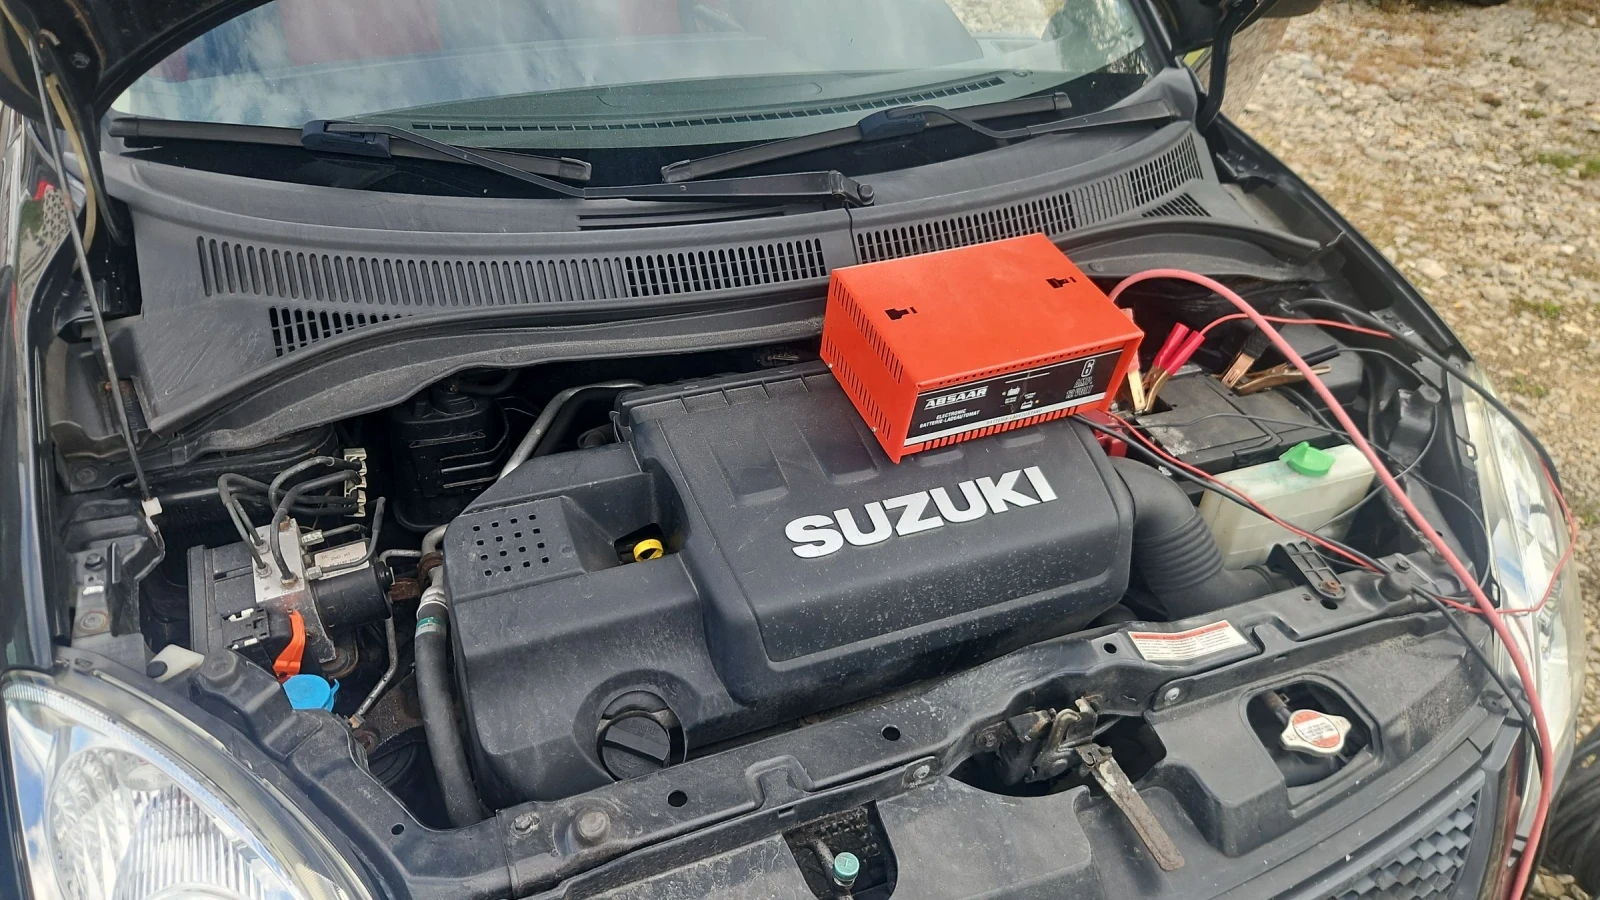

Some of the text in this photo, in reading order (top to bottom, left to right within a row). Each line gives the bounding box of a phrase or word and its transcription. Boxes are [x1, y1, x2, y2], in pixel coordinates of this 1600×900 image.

[1081, 359, 1095, 377] 6
[924, 386, 988, 410] ABSAAR
[936, 409, 967, 420] ELECTRONIC
[785, 465, 1058, 559] SUZUKI
